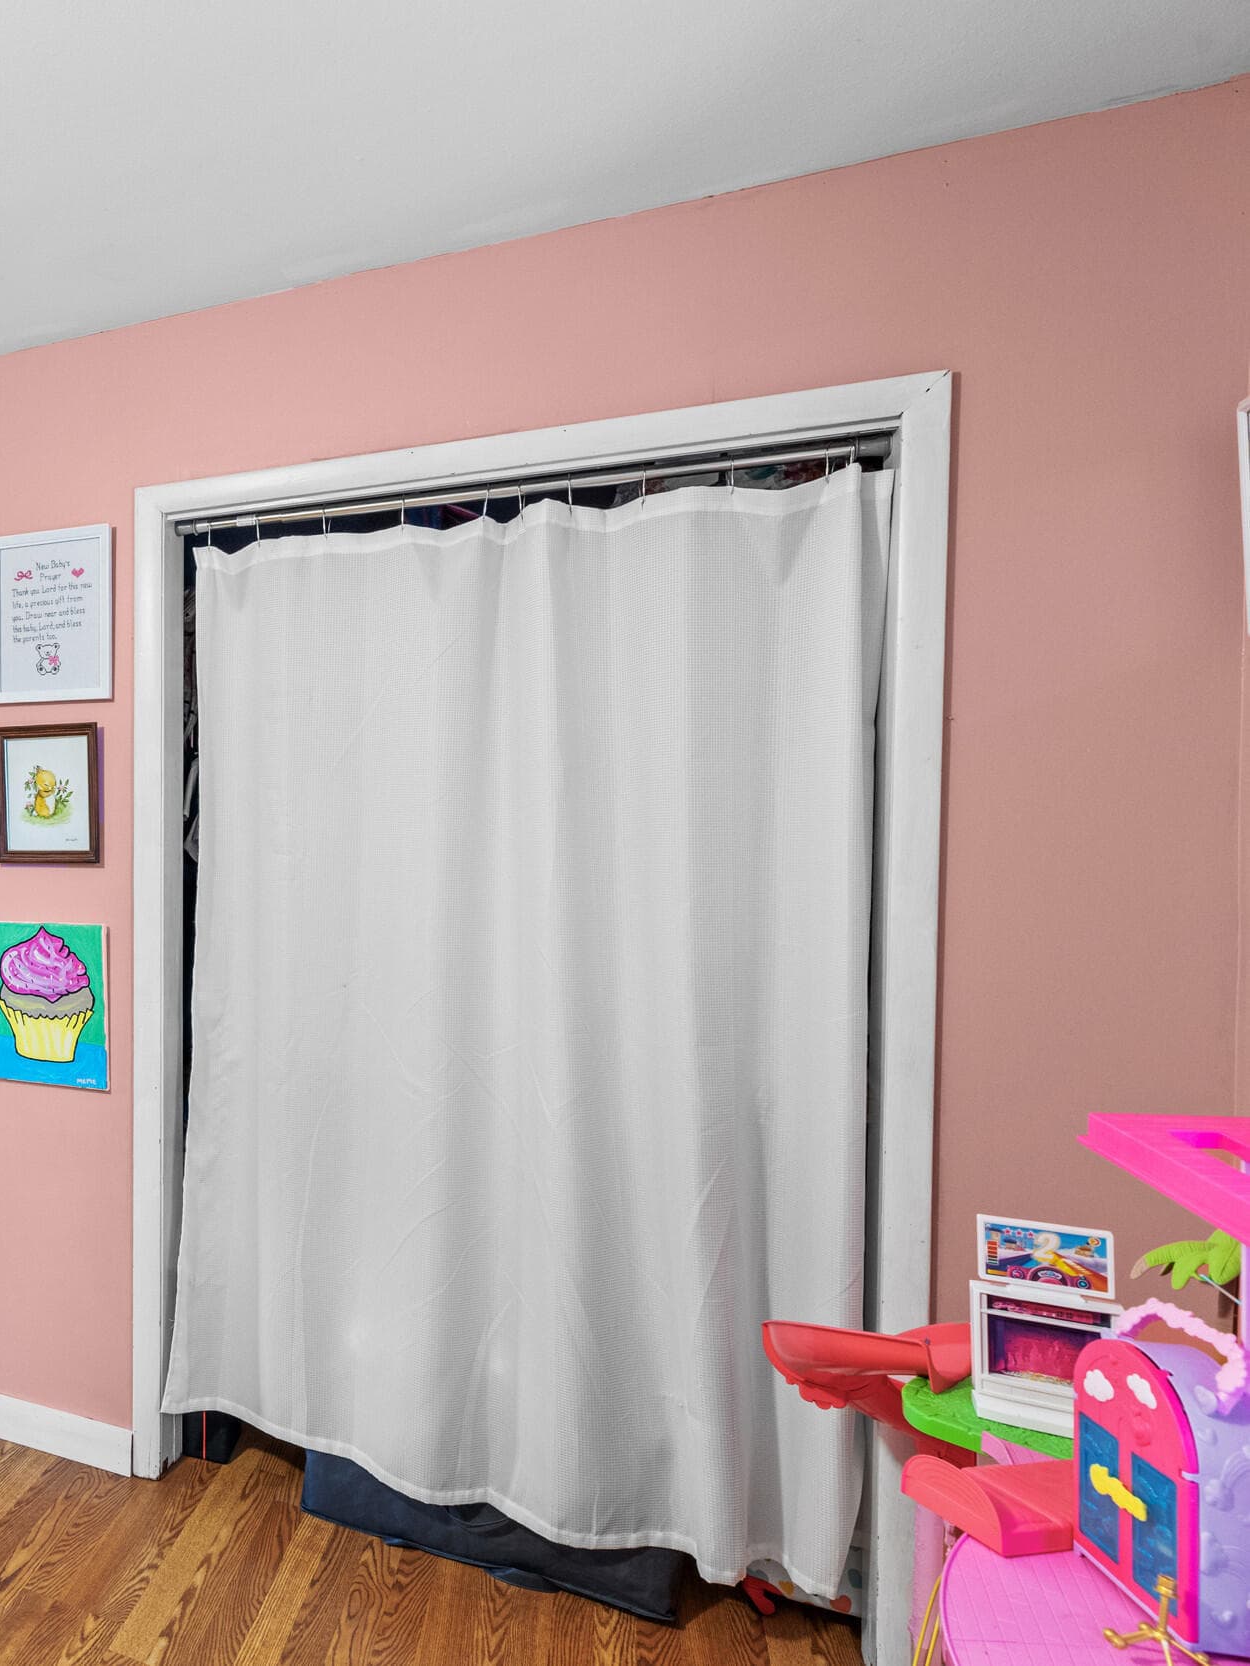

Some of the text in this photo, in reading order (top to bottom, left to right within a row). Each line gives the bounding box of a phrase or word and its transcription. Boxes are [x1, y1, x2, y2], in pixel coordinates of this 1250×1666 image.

[36, 560, 71, 571] New Baby's
[39, 572, 61, 581] Prayer
[12, 581, 93, 597] Thank you Lord for this new
[30, 599, 54, 609] precious
[55, 595, 65, 605] gift
[66, 594, 84, 603] from
[25, 611, 43, 620] Draw
[58, 607, 69, 616] and
[70, 606, 86, 615] bless
[55, 619, 66, 629] and
[66, 619, 82, 629] bless
[12, 634, 22, 643] the
[22, 632, 45, 644] parents
